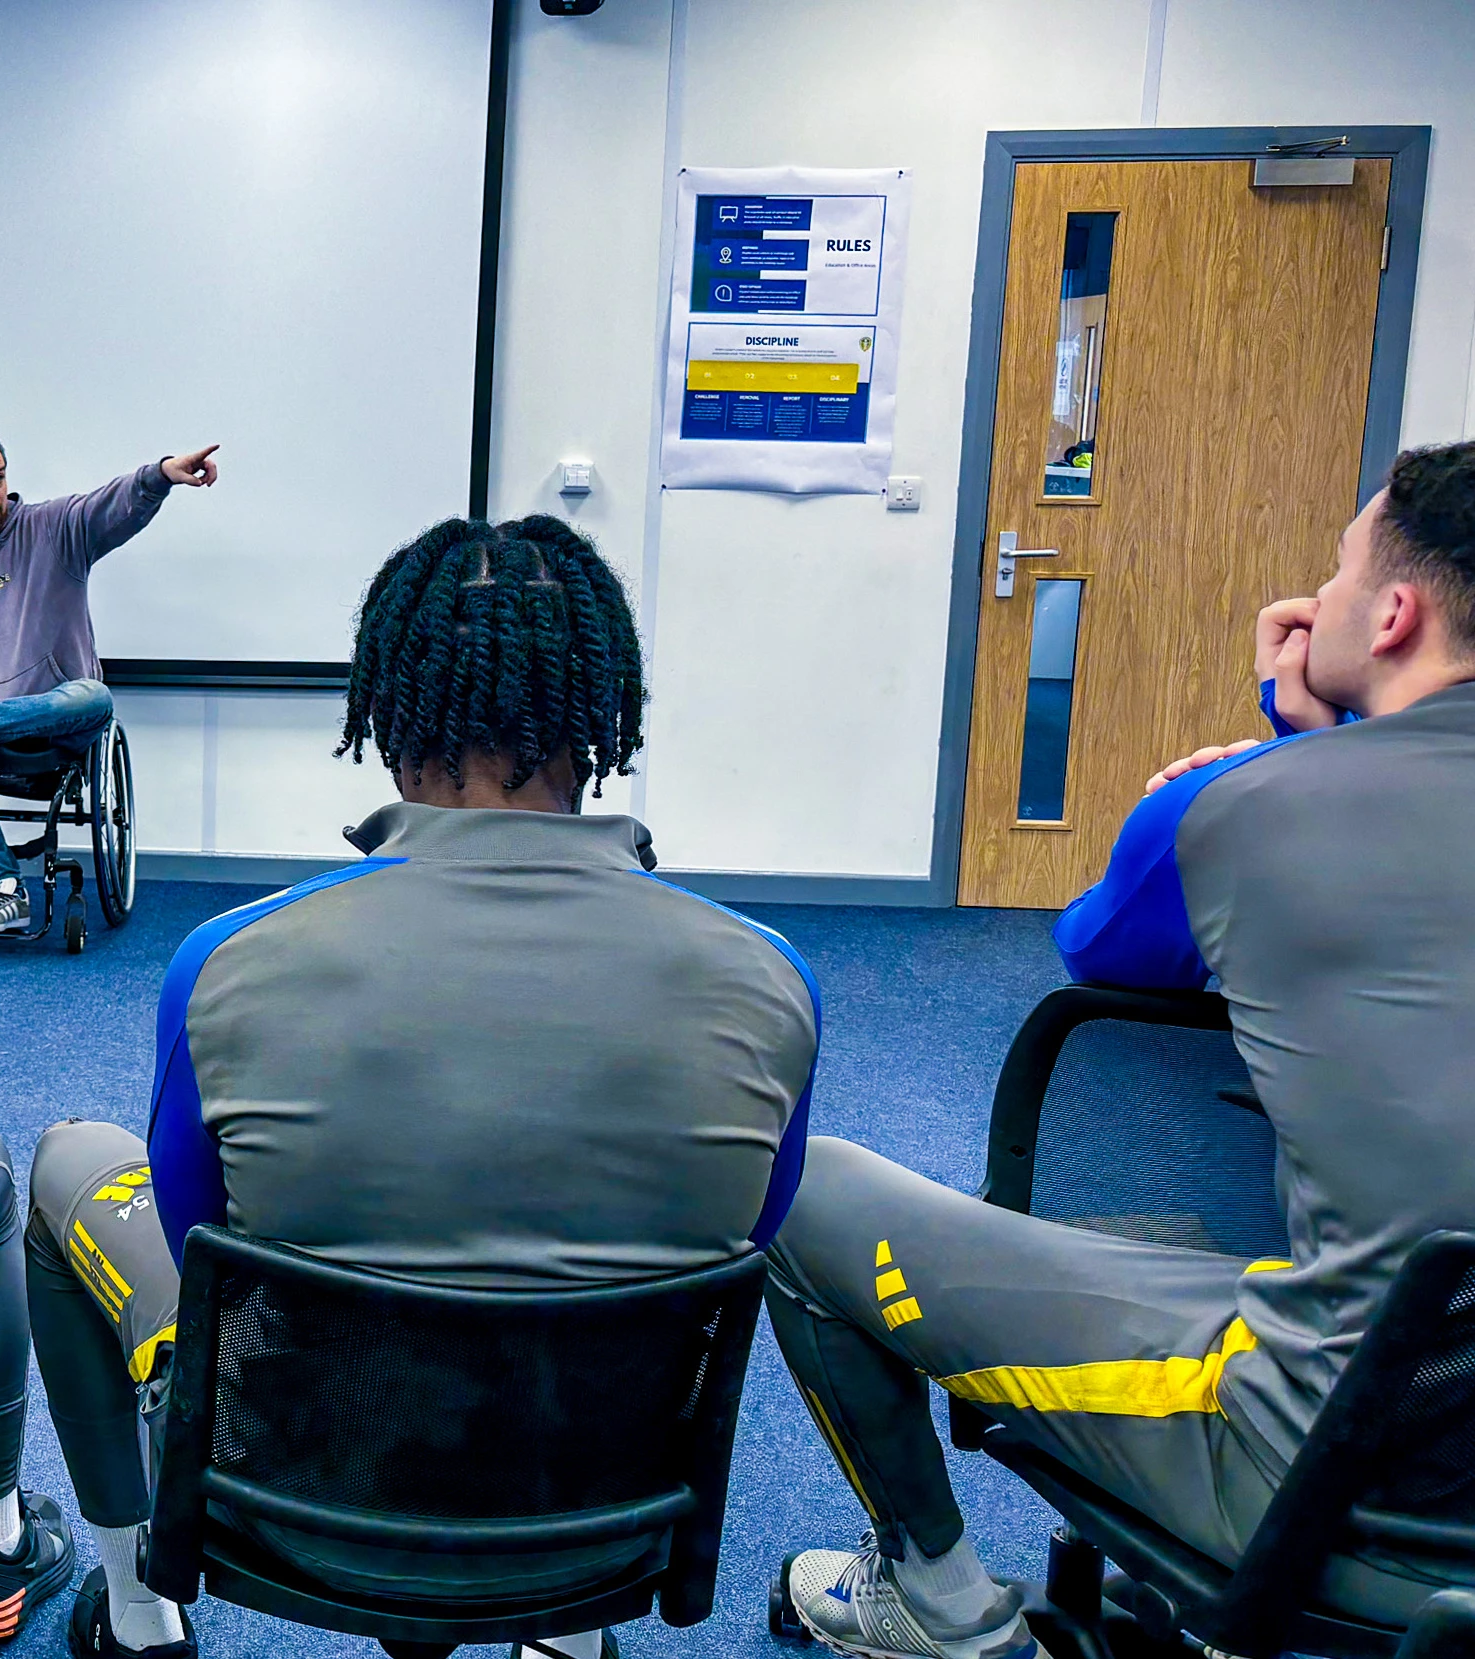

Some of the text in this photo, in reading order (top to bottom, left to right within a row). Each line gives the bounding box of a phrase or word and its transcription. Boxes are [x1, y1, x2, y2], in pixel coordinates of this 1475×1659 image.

[826, 239, 871, 252] RULES
[745, 336, 800, 347] DISCIPLINE
[116, 1194, 150, 1222] 54
